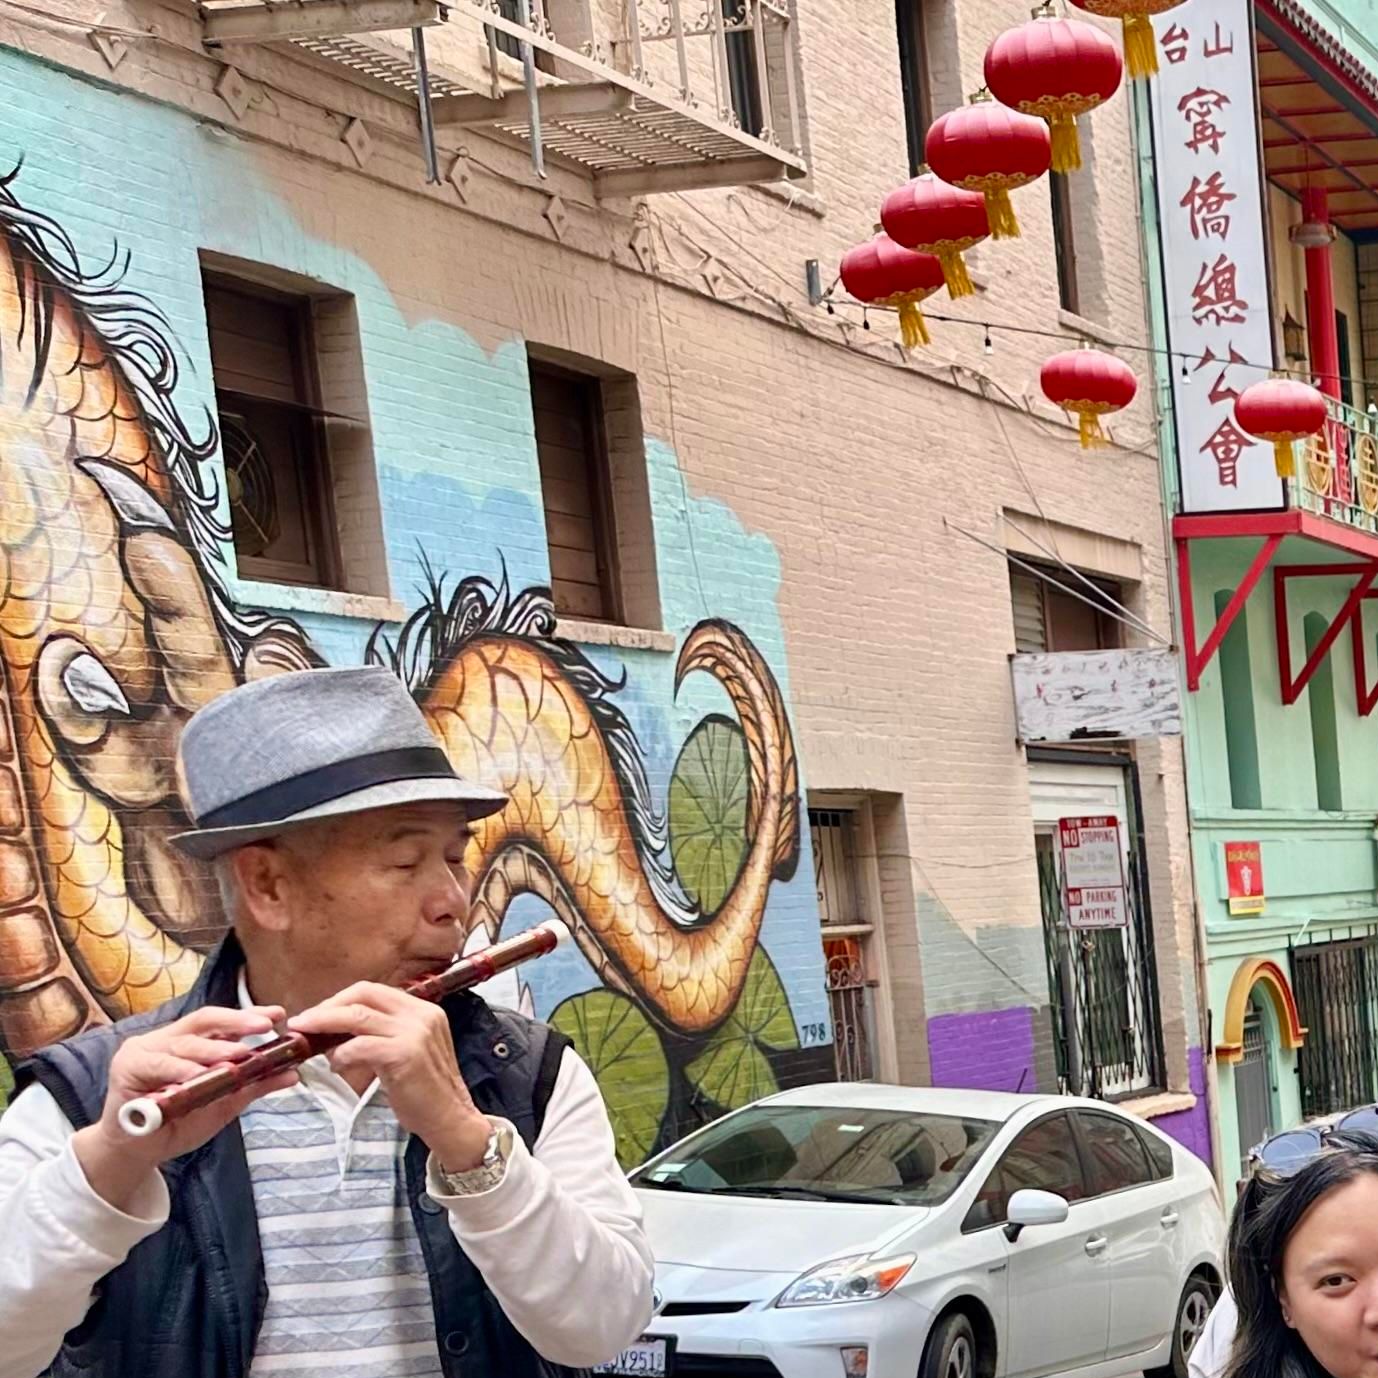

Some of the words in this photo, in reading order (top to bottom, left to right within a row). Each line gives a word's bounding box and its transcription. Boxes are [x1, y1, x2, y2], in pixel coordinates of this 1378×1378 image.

[1062, 830, 1078, 847] NO
[1080, 830, 1115, 844] STOPPING
[1068, 891, 1081, 905] NO
[1086, 890, 1117, 903] PARKING
[1079, 907, 1117, 920] ANYTIME
[801, 1022, 827, 1045] 798
[603, 1351, 656, 1372] JV951
